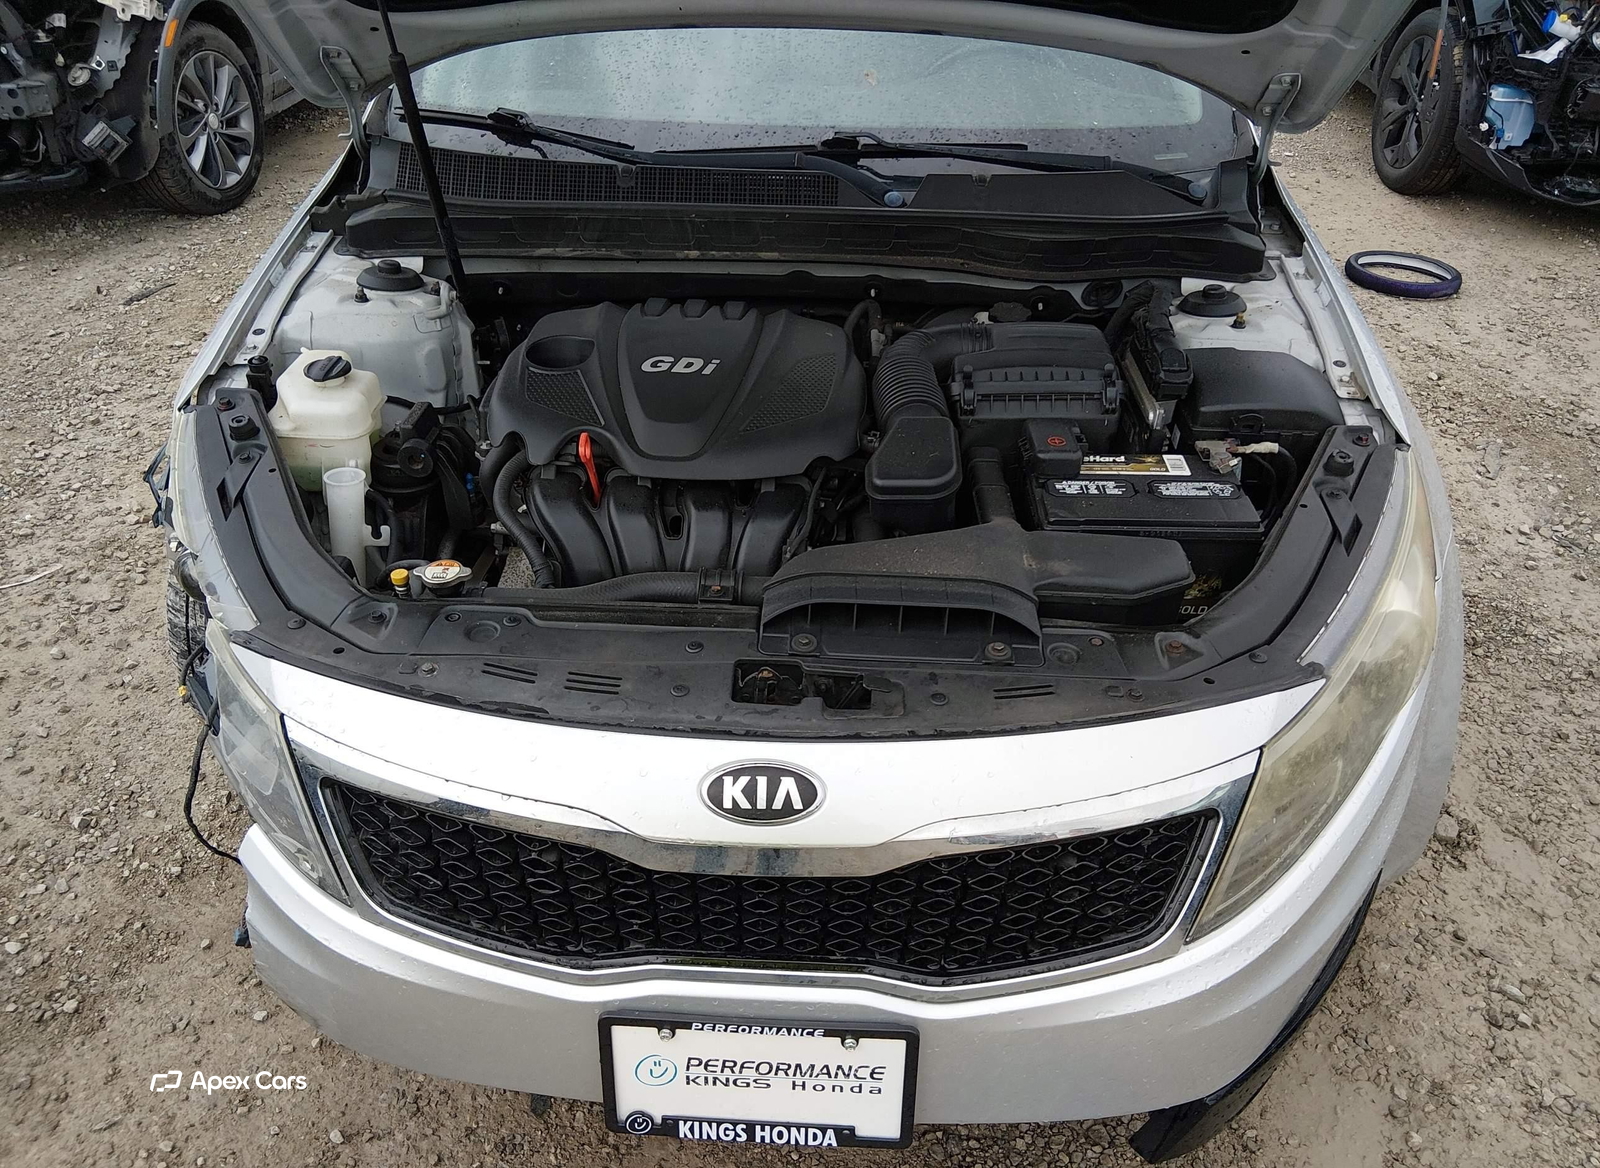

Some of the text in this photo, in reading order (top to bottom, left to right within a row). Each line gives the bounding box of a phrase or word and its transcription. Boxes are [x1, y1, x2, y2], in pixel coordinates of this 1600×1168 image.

[641, 355, 721, 375] GDi
[722, 775, 804, 810] KIA
[691, 1022, 825, 1038] PERFORMANCE
[685, 1056, 887, 1081] PERFORMANCE
[685, 1074, 882, 1095] KINGS Honda
[678, 1120, 838, 1147] KINGS HONDA
